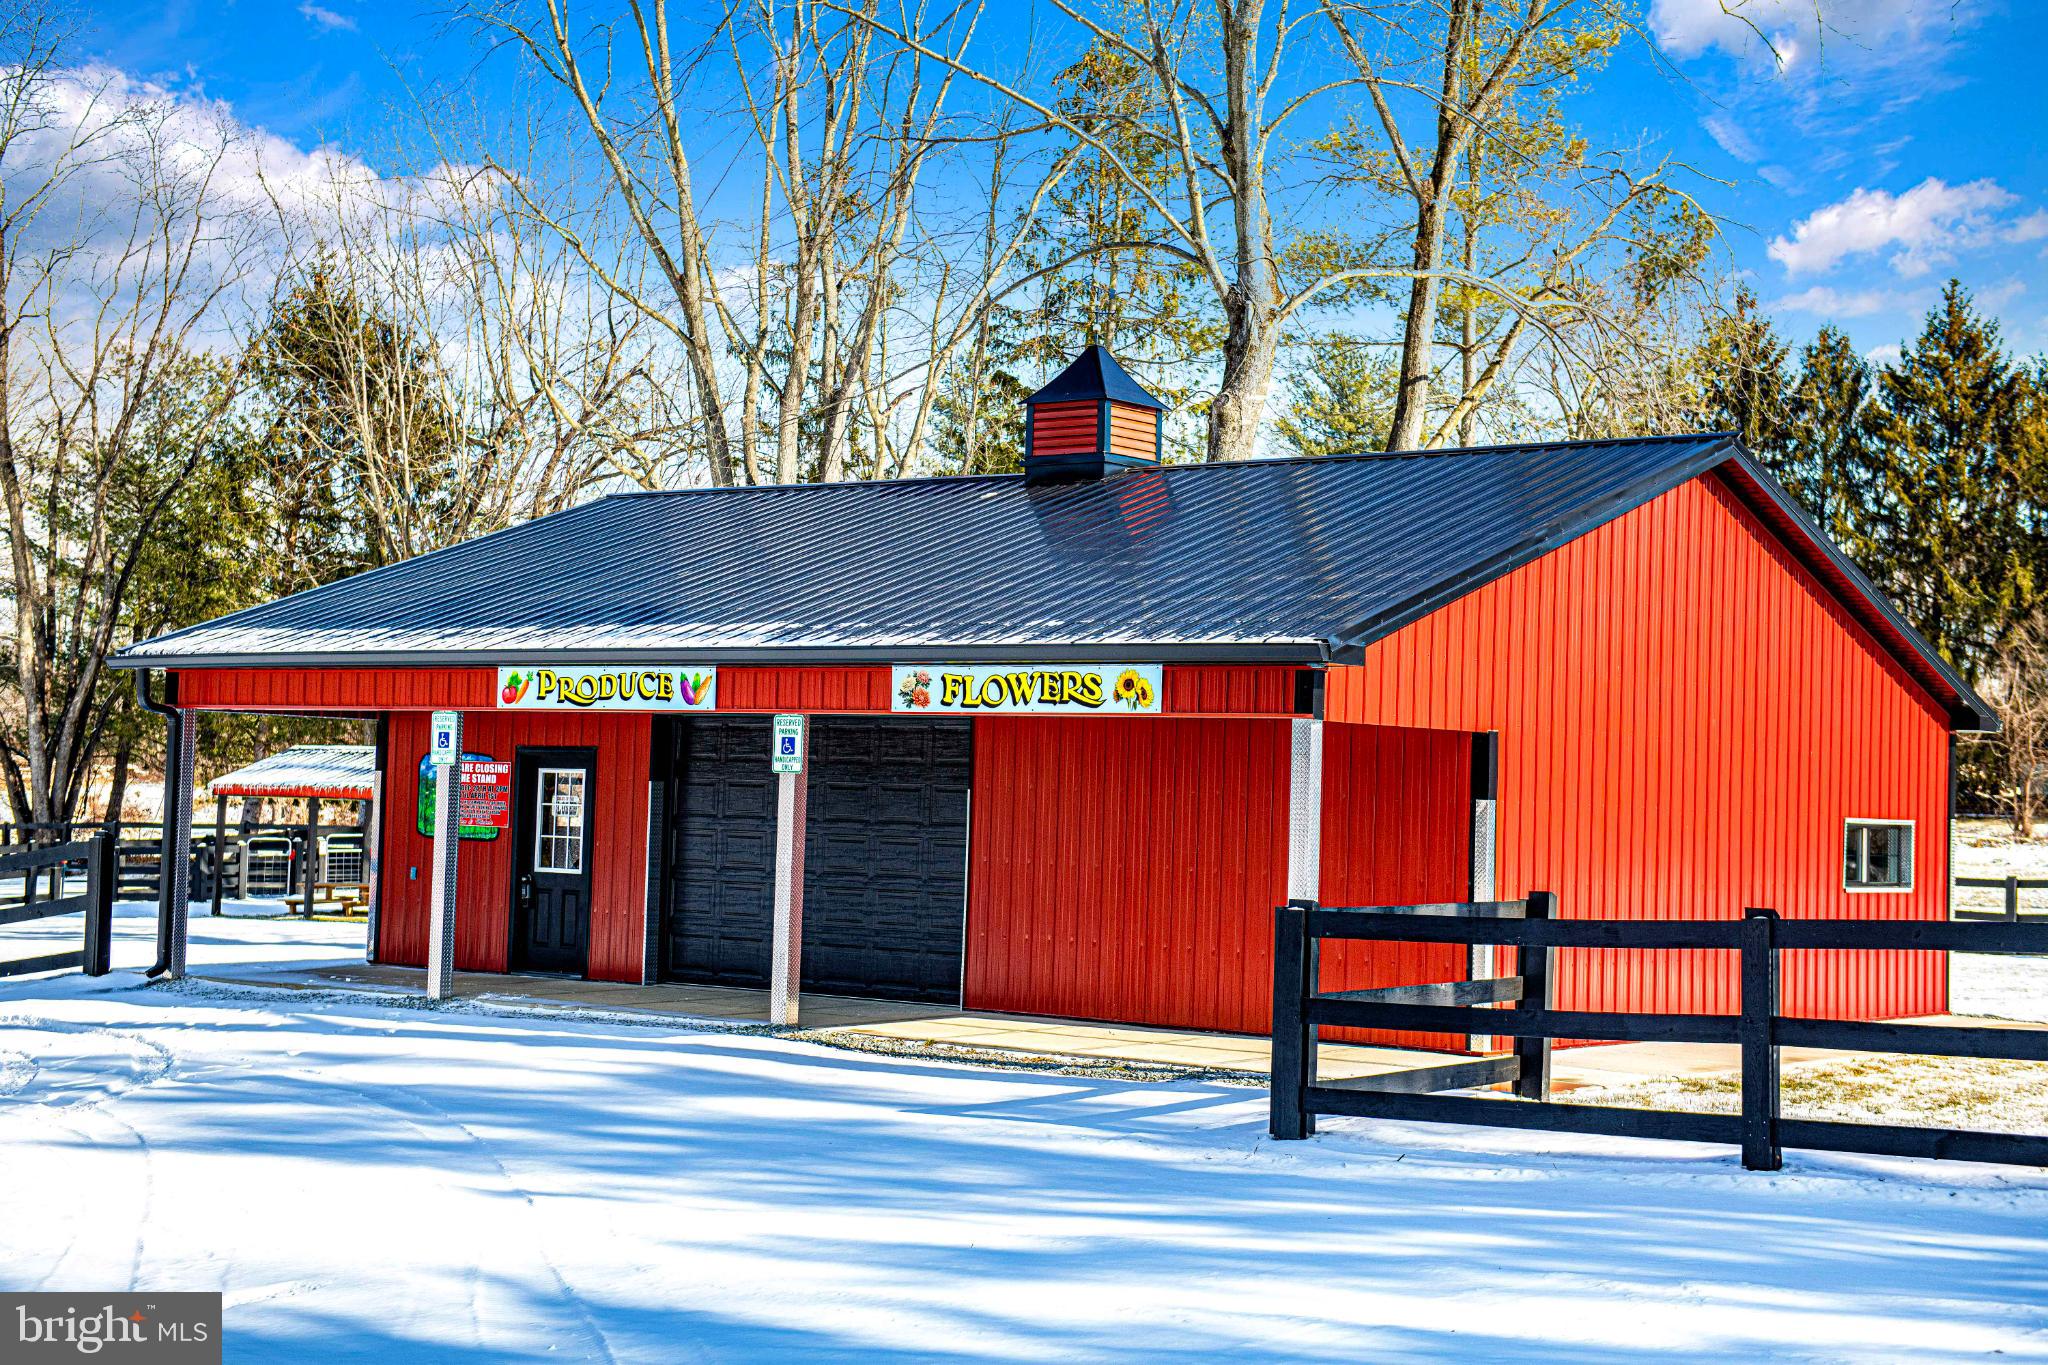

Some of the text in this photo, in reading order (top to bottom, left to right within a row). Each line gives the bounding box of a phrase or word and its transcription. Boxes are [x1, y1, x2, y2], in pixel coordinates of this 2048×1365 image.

[537, 670, 674, 706] PRODUCE
[940, 671, 1107, 709] FLOWERS
[776, 718, 802, 727] RESERVED
[778, 728, 799, 736] PARKING
[774, 755, 801, 764] HANDICAPPED
[475, 763, 509, 774] CLOSING
[461, 773, 497, 784] HE STAND
